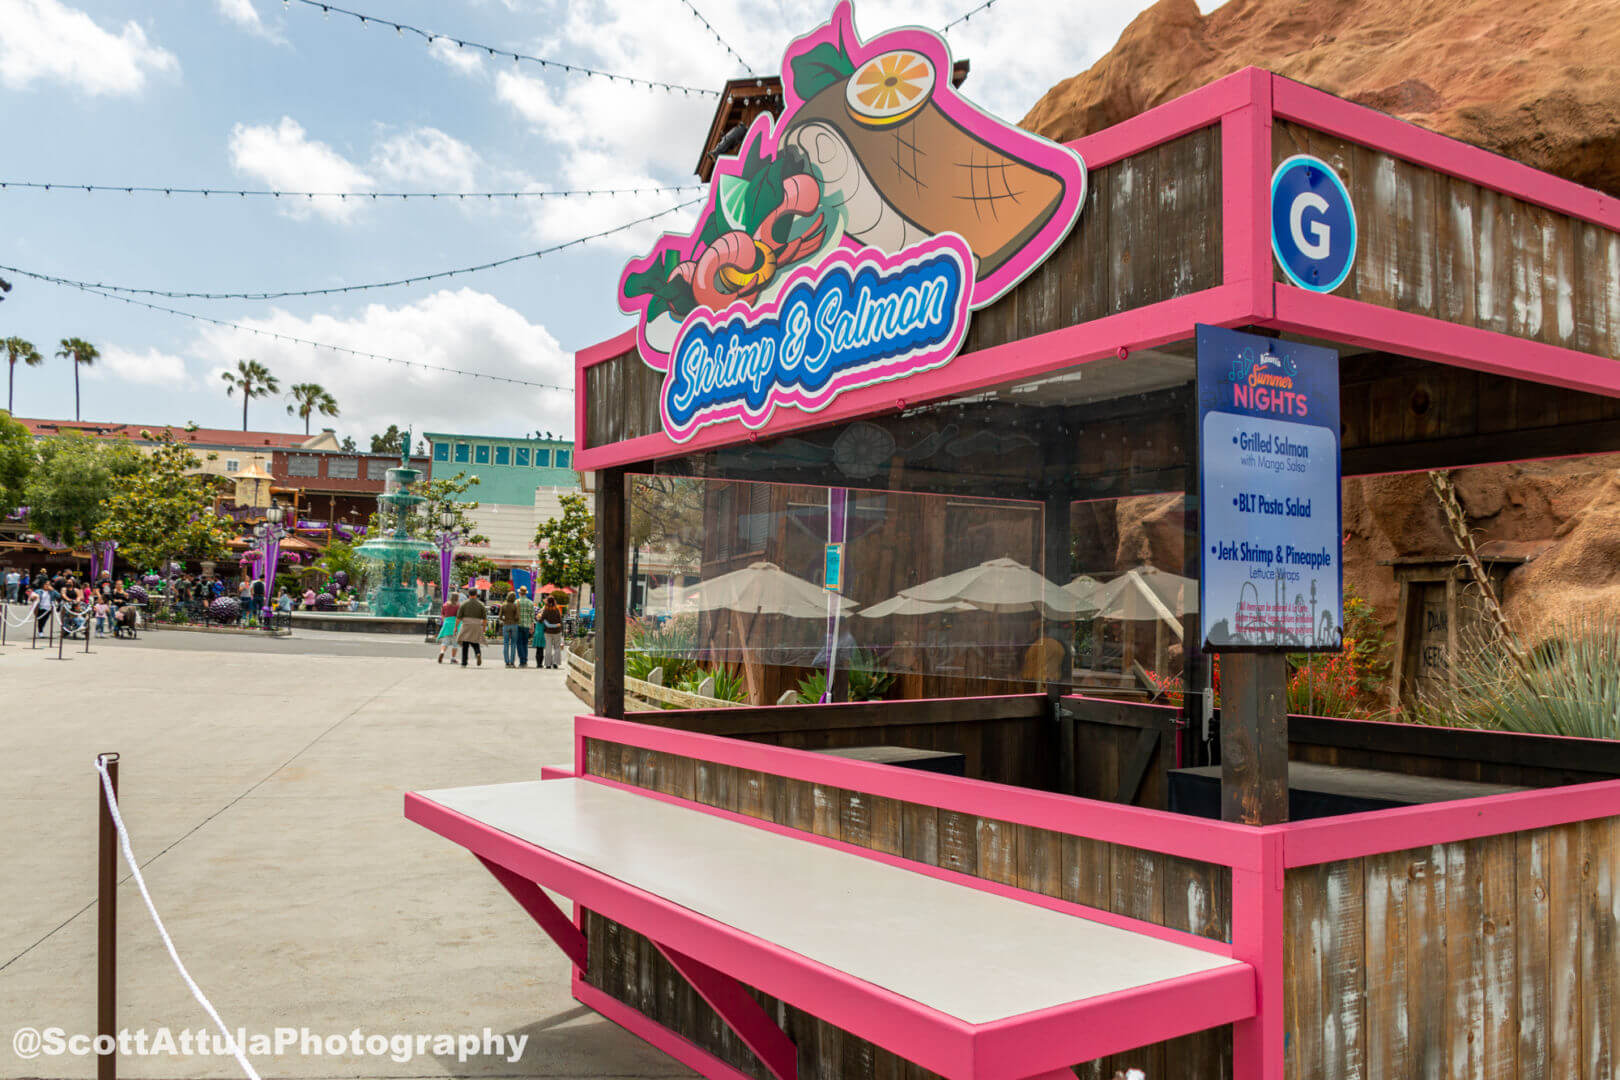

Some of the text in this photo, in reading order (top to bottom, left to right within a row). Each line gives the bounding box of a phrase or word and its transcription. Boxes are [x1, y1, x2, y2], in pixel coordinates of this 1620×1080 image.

[1289, 192, 1330, 260] G
[673, 276, 948, 410] Shrimp & Salmon
[1248, 364, 1293, 389] Summer
[1233, 383, 1308, 416] NIGHTS
[1240, 431, 1308, 458] Grilled Salmon
[1241, 455, 1306, 473] with Mango Salsa
[1239, 493, 1311, 518] BLT Pasta Salad
[1218, 540, 1331, 570] Jerk Shrimp & Pineapple
[1249, 566, 1275, 580] Lettuce
